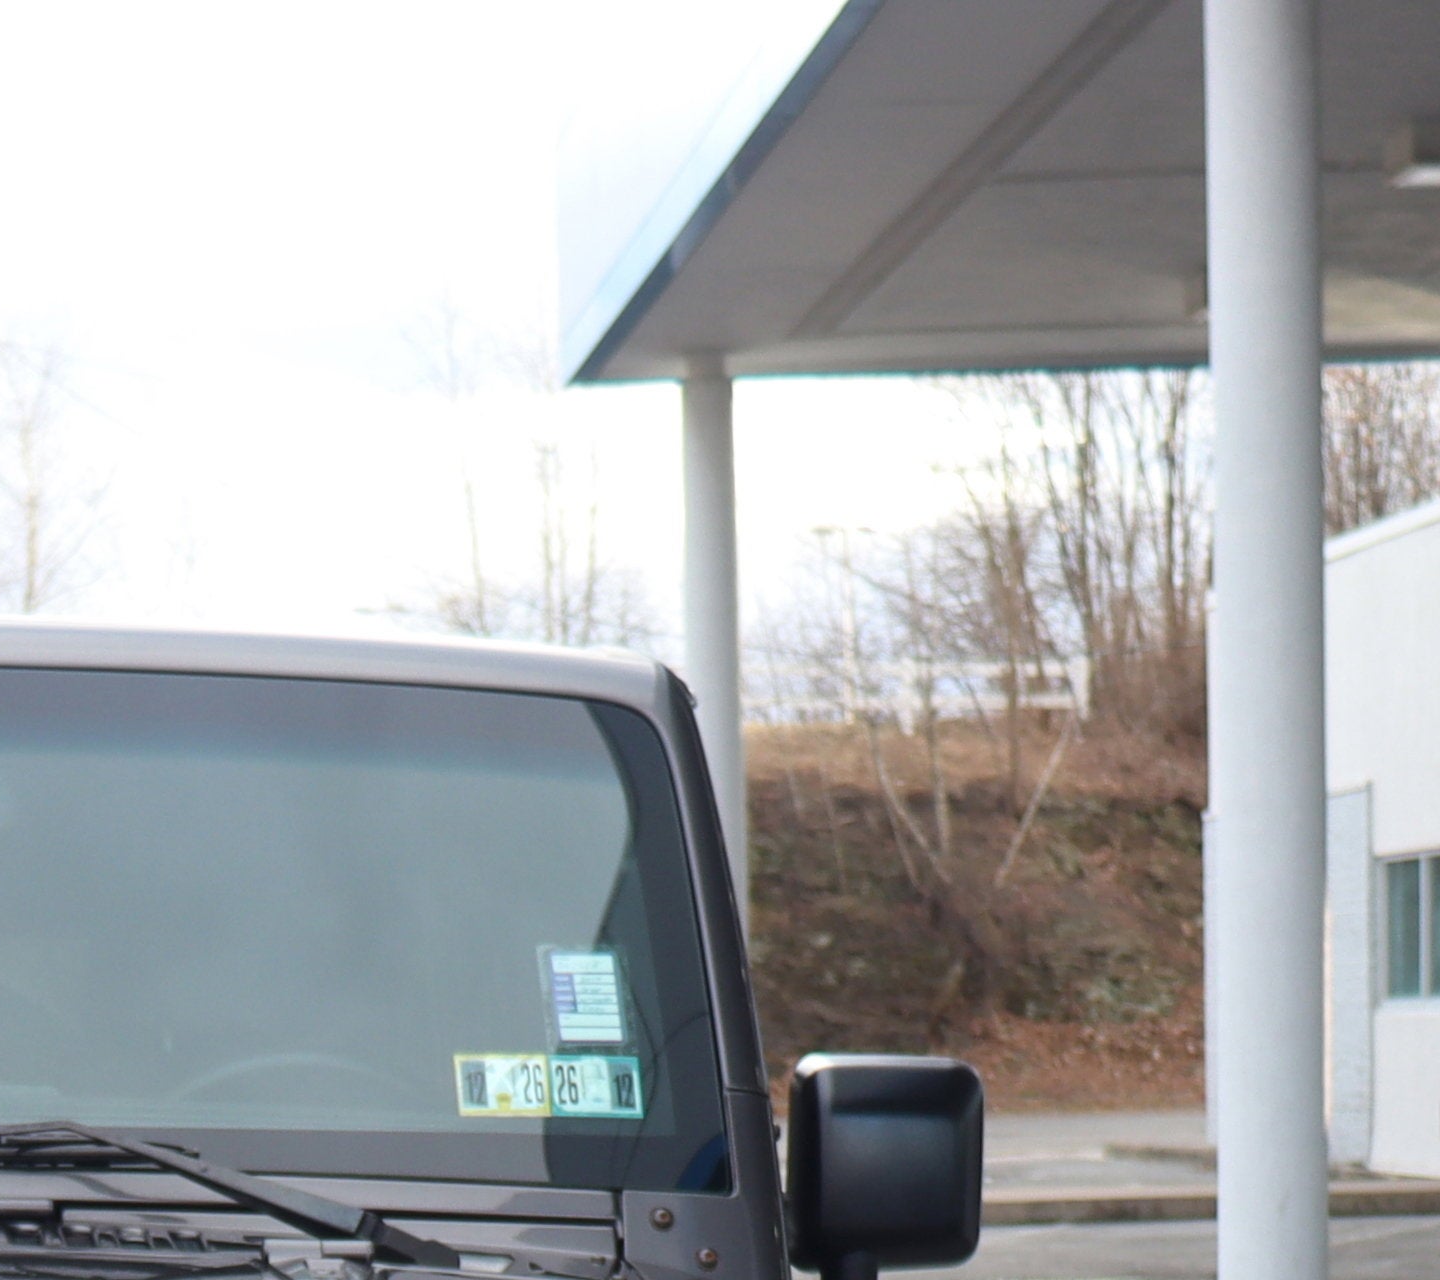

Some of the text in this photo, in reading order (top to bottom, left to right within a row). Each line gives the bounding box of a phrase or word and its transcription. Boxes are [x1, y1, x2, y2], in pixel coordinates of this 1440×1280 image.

[466, 1063, 545, 1105] 12 26
[555, 1065, 636, 1108] 26 12
